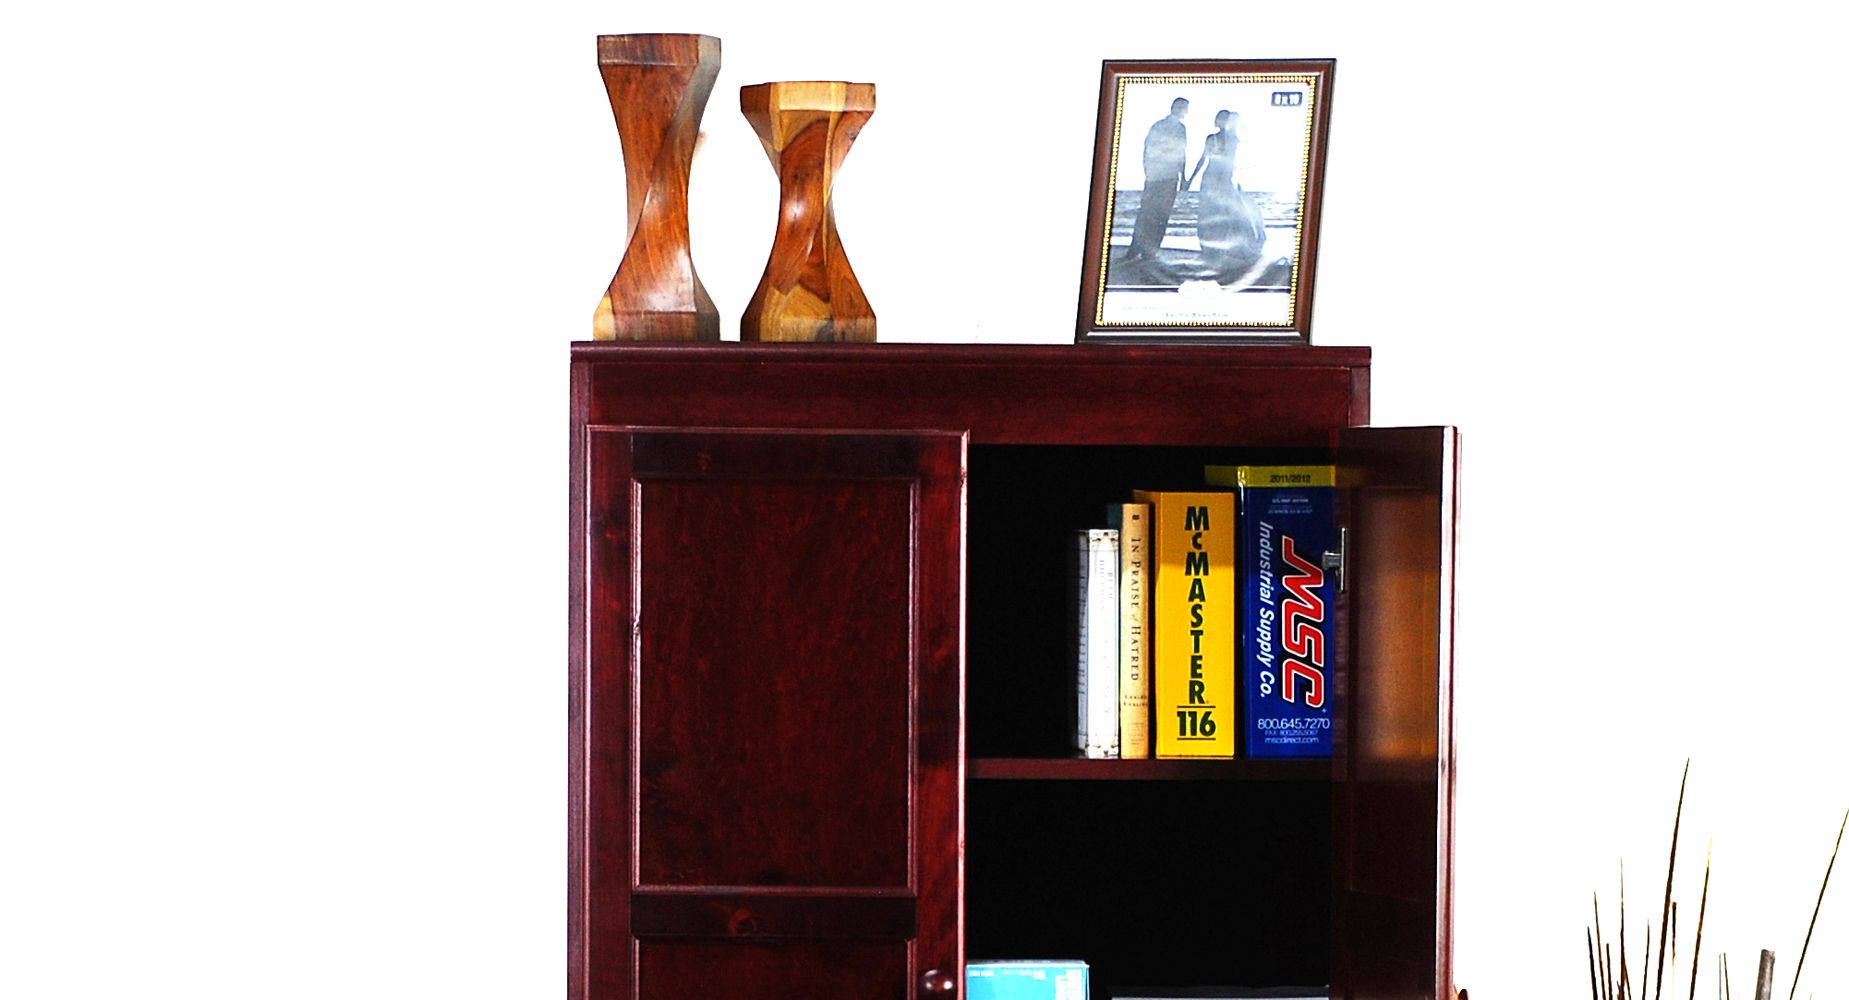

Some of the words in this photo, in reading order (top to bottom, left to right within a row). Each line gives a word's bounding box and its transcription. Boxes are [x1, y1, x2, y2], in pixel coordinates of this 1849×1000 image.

[1270, 474, 1311, 483] 2011/2012
[1131, 538, 1141, 553] IN
[1259, 520, 1274, 605] Industrial
[1131, 561, 1141, 609] PRAISE
[1281, 534, 1325, 709] MSC
[1257, 607, 1275, 667] Supply
[1131, 626, 1141, 681] HATRED
[1259, 670, 1275, 698] Co.
[1177, 711, 1216, 736] 116
[1257, 718, 1331, 729] 800.645.7270
[1264, 736, 1320, 744] mscdirect.com
